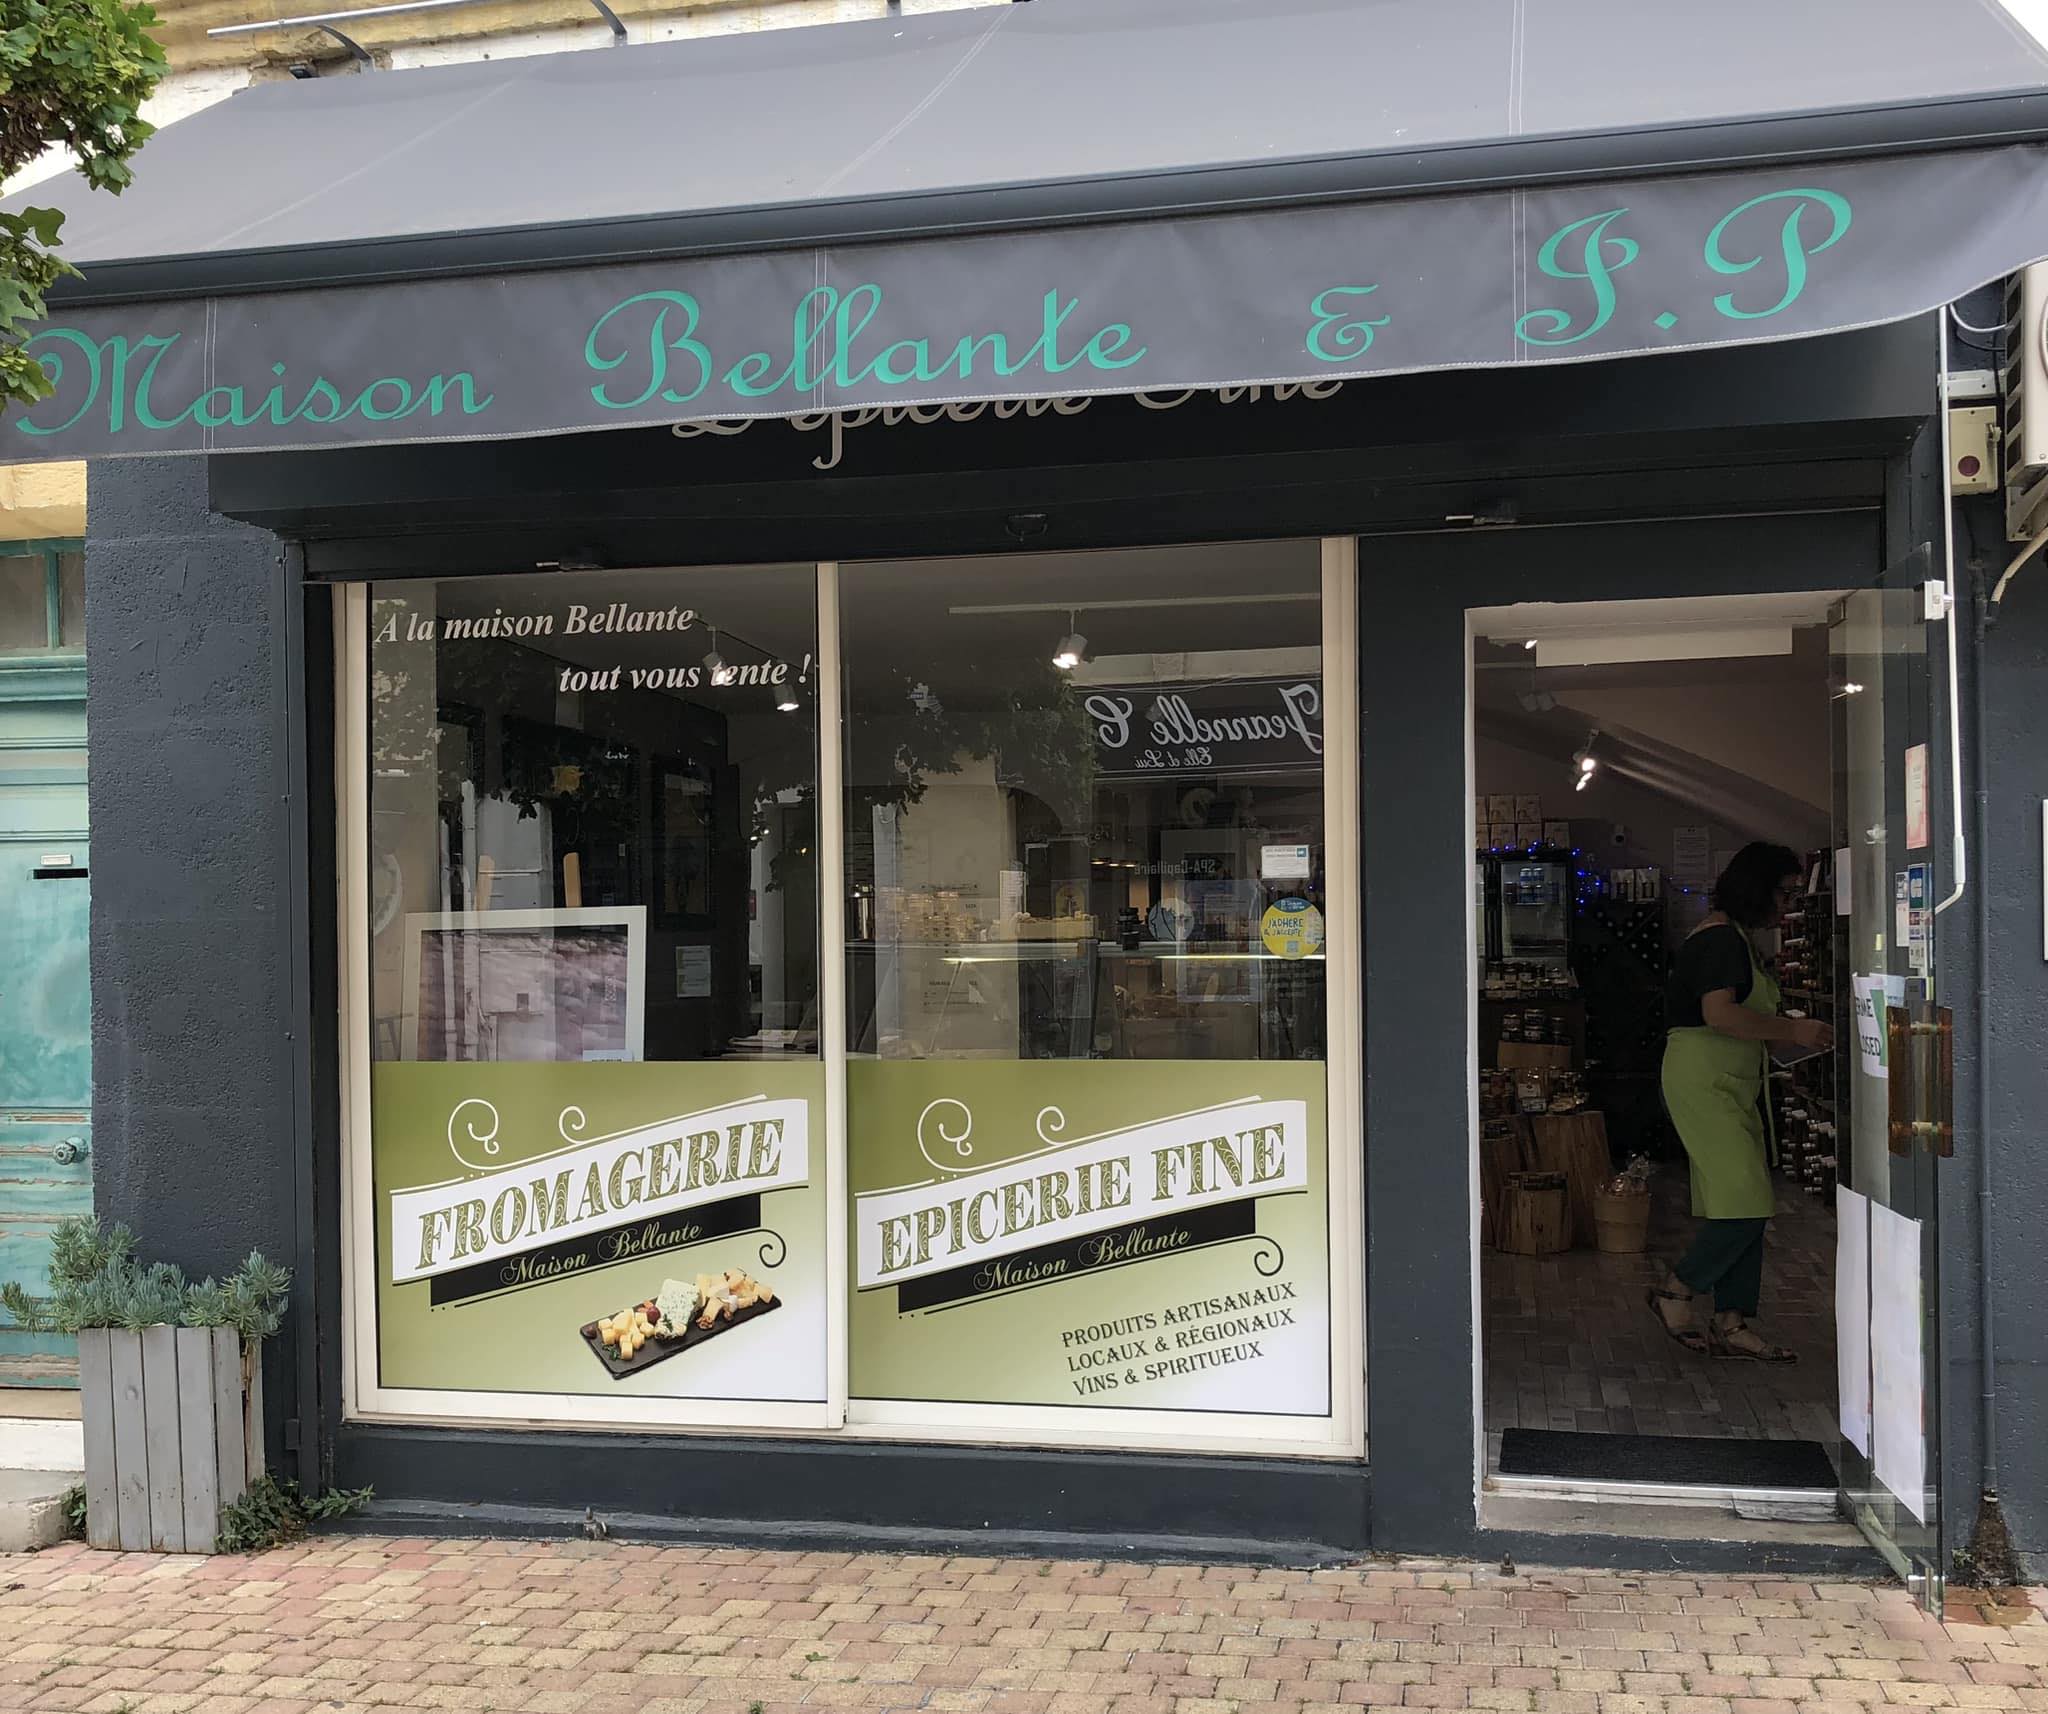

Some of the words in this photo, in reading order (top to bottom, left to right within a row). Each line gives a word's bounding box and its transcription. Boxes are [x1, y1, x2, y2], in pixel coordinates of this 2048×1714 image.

[16, 328, 495, 436] Maison
[584, 283, 1147, 410] Bellante
[1305, 284, 1391, 362] &
[406, 612, 434, 642] la
[443, 608, 554, 640] maison
[563, 602, 695, 635] Bellante
[559, 664, 622, 693] tout
[632, 664, 701, 689] vous
[709, 656, 788, 687] tente
[798, 653, 812, 684] !
[415, 1117, 785, 1270] FROMAGERIE
[877, 1155, 1132, 1276] EPICERIE
[1150, 1122, 1286, 1202] FINE
[500, 1250, 591, 1285] Maison
[597, 1219, 703, 1262] Bellante
[973, 1255, 1070, 1292] Maison
[1078, 1225, 1192, 1267] Bellante
[1062, 1312, 1157, 1348] PRODUITS
[1163, 1281, 1297, 1327] ARTISANAUX
[1067, 1340, 1149, 1372] LOCAUX
[1154, 1335, 1170, 1353] &
[1175, 1308, 1296, 1349] RÉGIONAUX
[1072, 1372, 1119, 1396] VINS
[1124, 1367, 1140, 1385] &
[1144, 1341, 1265, 1380] SPIRITUEUX
